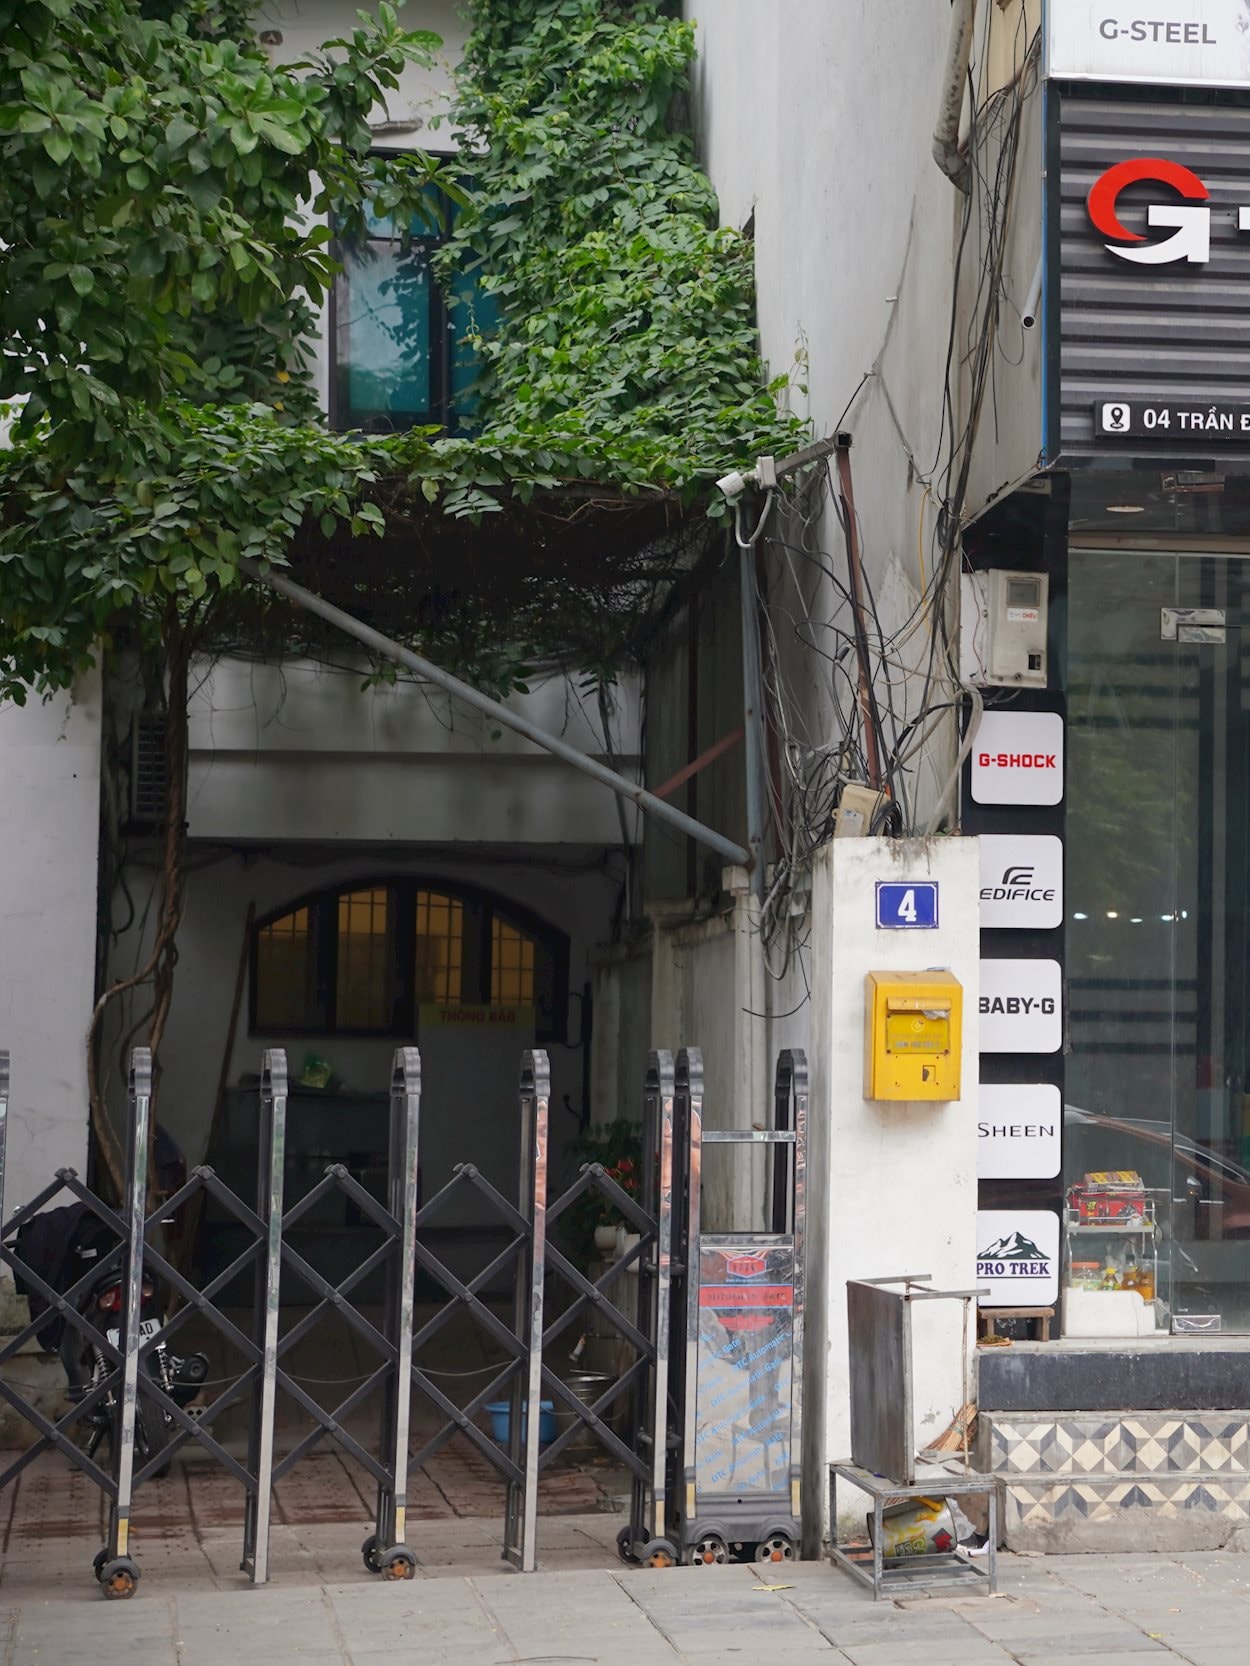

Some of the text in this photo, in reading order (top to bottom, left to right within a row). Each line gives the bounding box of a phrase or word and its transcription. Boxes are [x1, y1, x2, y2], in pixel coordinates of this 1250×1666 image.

[1099, 18, 1217, 44] G-STEEL
[1143, 409, 1171, 429] 04
[1177, 406, 1234, 430] TRẦN
[979, 753, 1056, 769] G-SHOCK
[980, 888, 1055, 901] EDIFICE
[897, 889, 917, 922] 4
[979, 996, 1055, 1015] BABY-G
[976, 1262, 1050, 1275] PRO TREK
